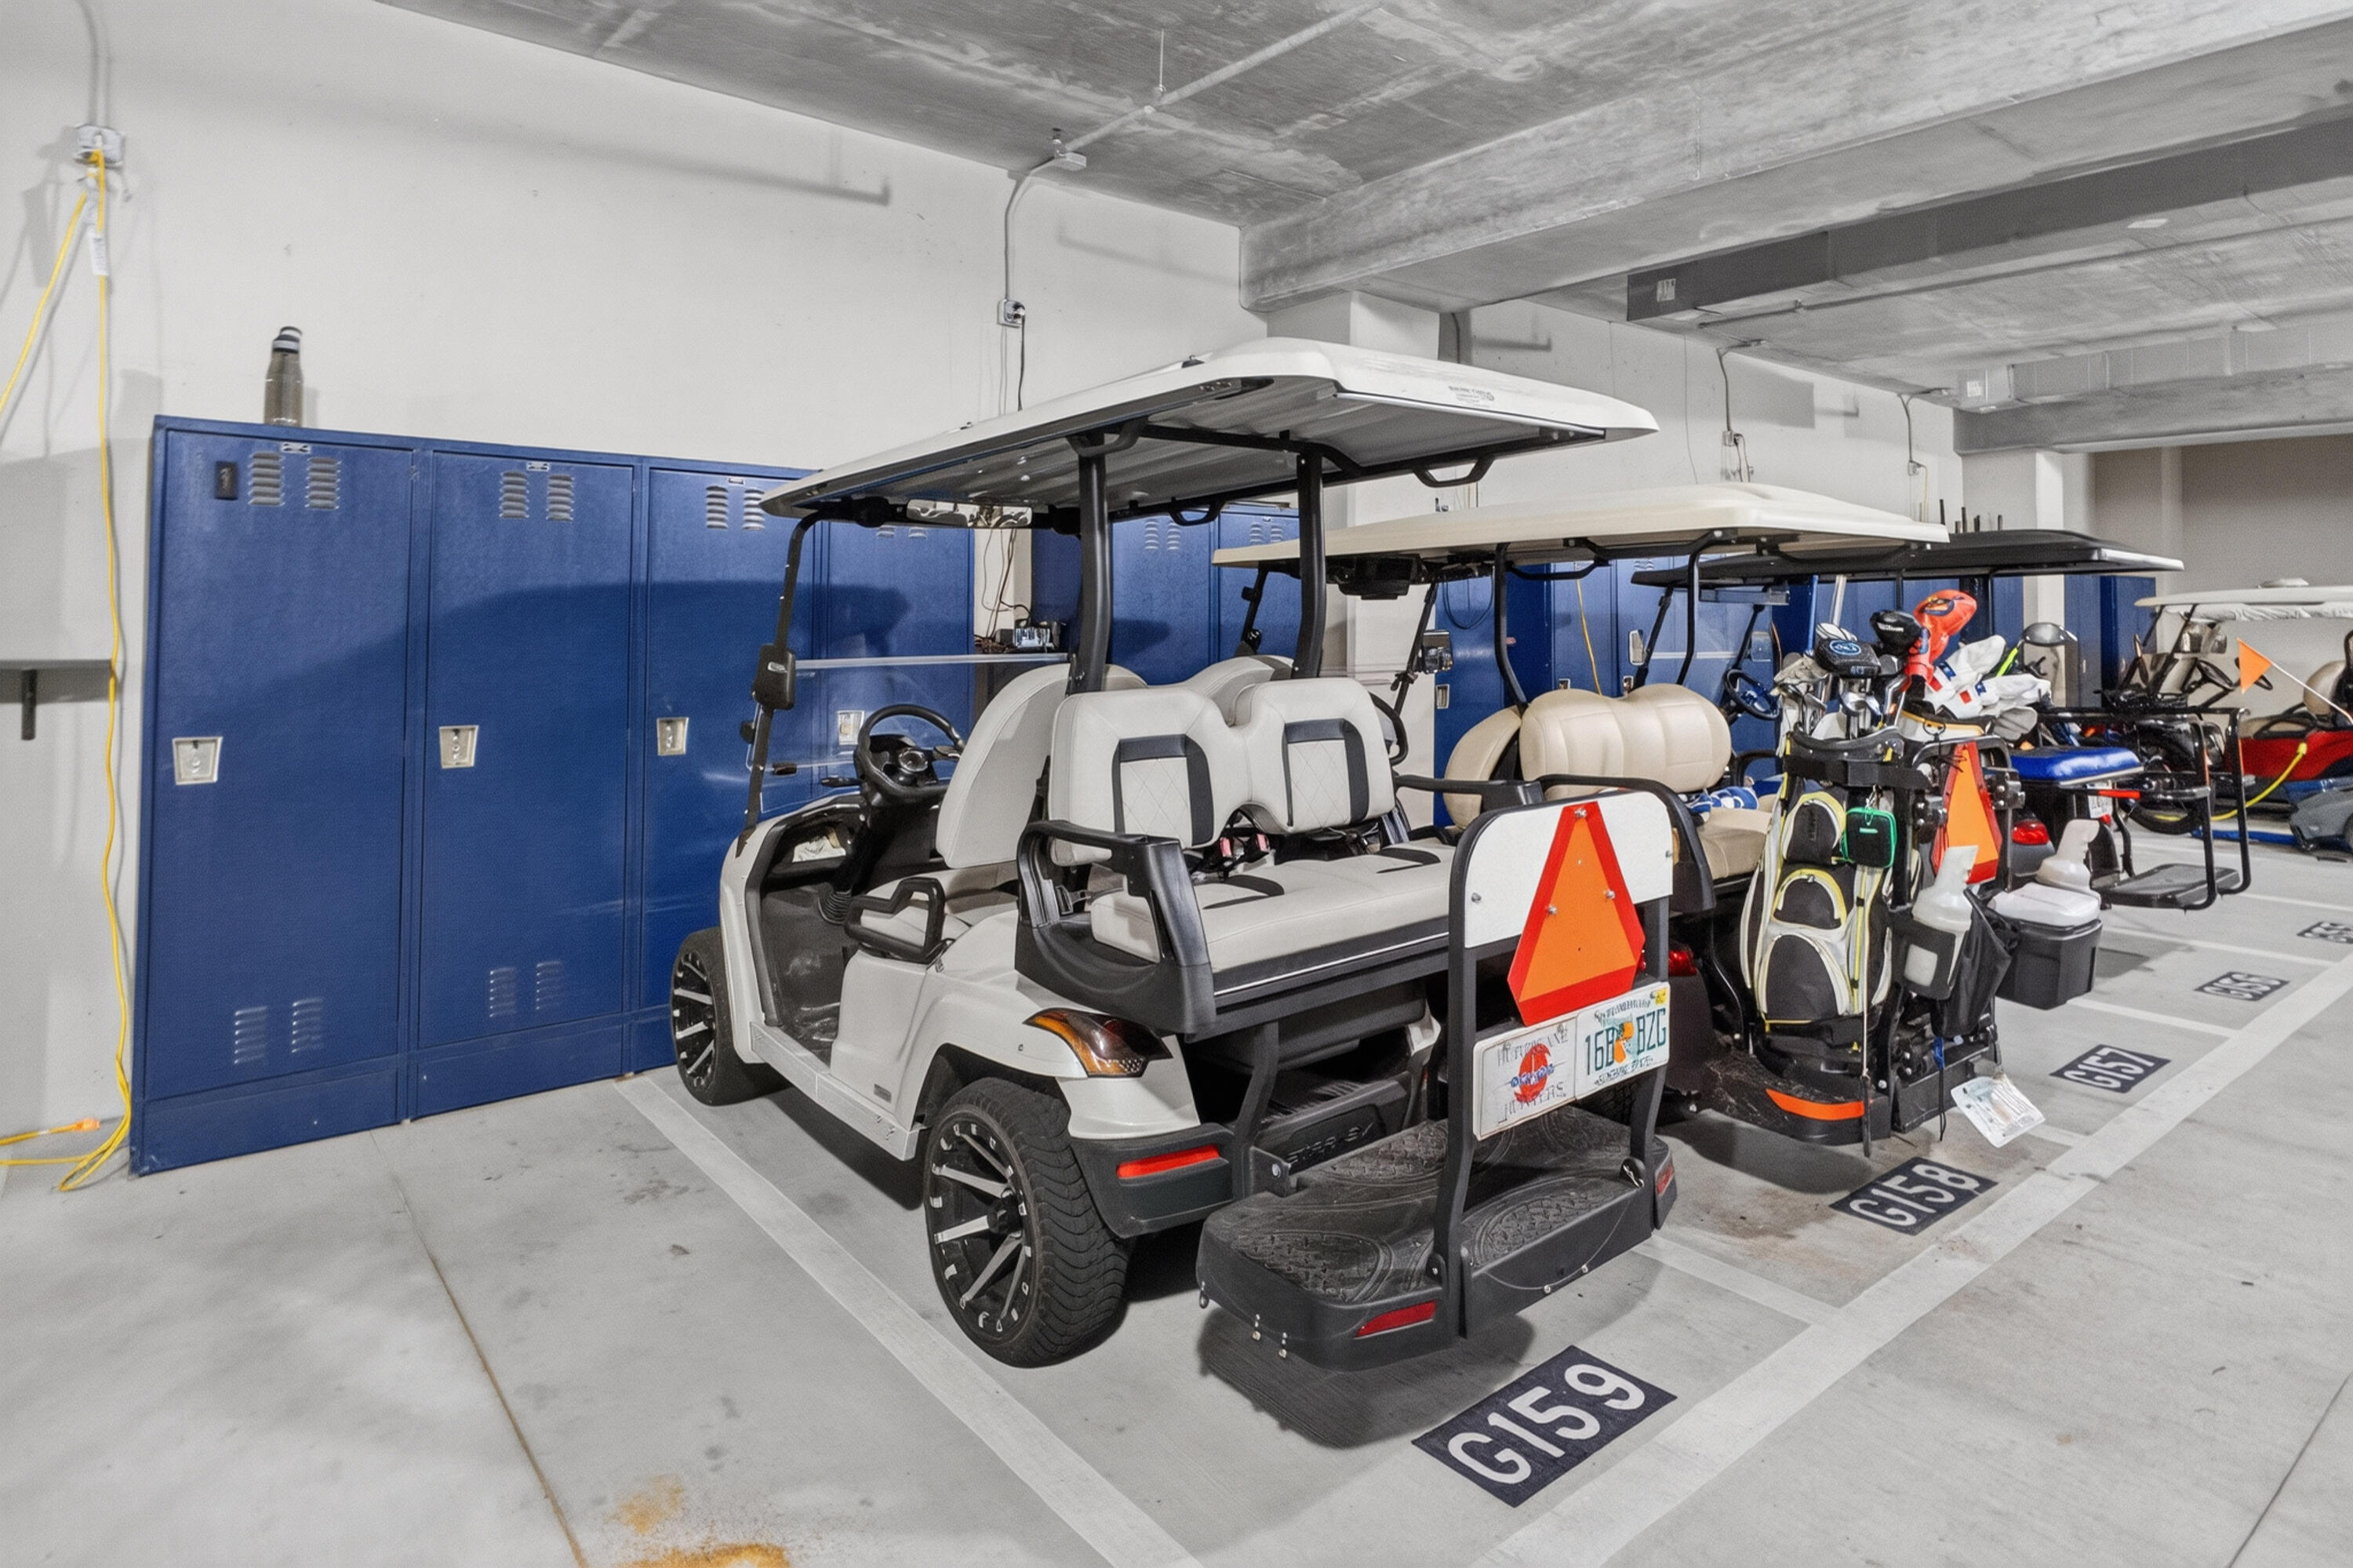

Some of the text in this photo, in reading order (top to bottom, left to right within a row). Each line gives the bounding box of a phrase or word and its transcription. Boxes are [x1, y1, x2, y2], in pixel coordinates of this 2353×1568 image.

[1636, 1007, 1667, 1056] BZG
[2064, 1045, 2155, 1090] G157
[1849, 1162, 1980, 1227] G158
[1448, 1363, 1646, 1484] G159
